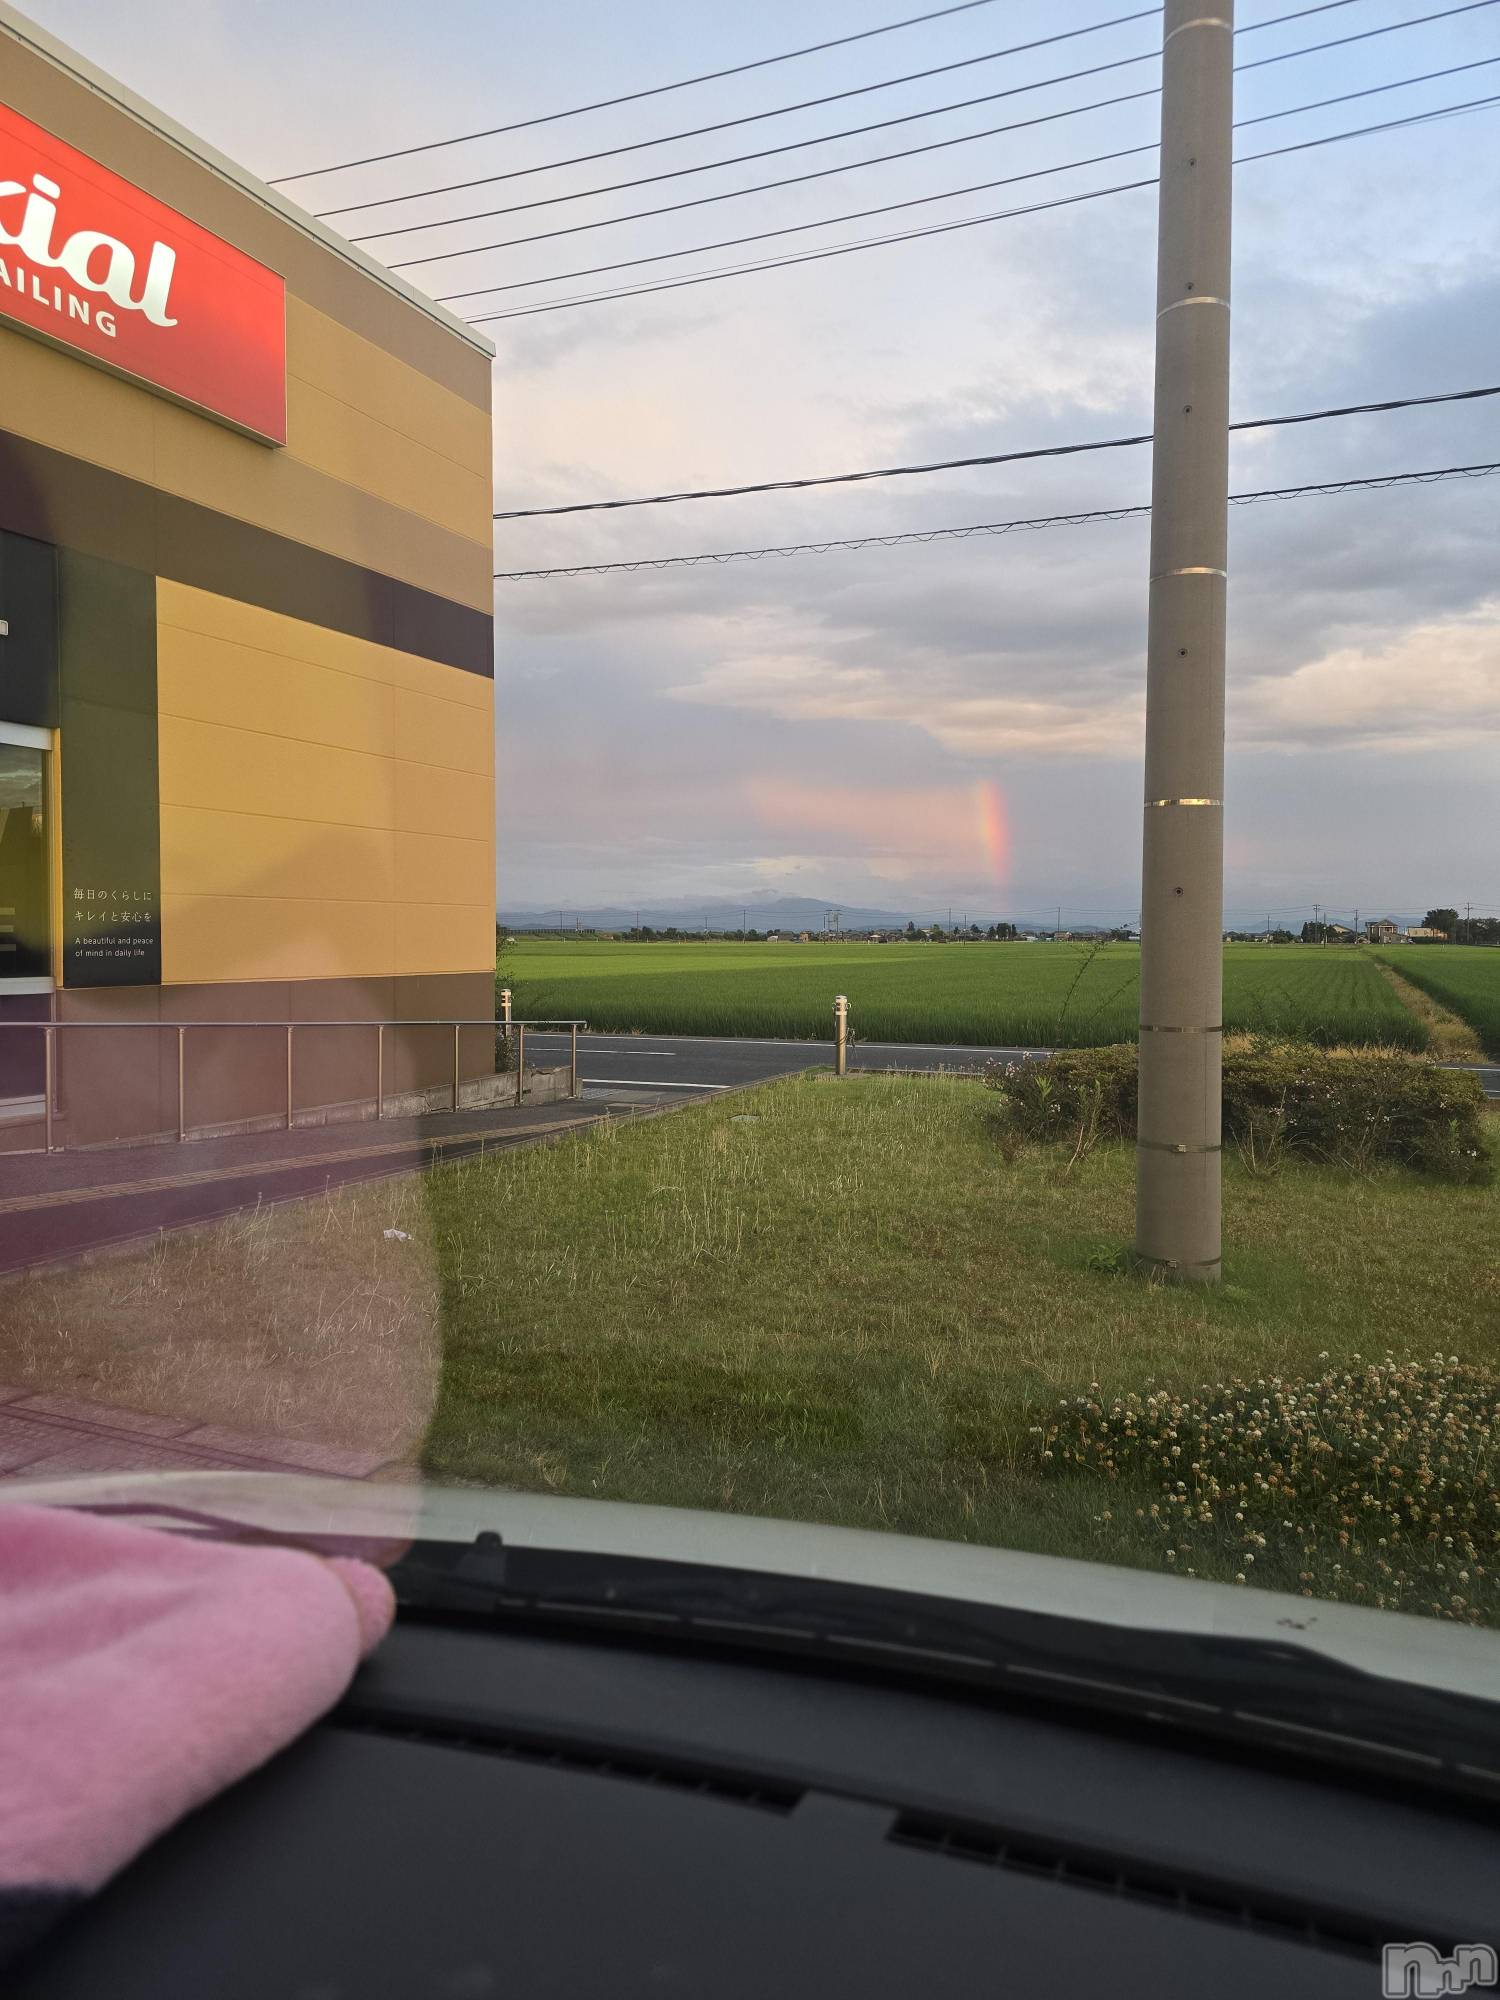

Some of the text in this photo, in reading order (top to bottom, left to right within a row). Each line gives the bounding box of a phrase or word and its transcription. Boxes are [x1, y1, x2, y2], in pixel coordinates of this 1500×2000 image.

[74, 888, 152, 901] 毎日のくらしに
[74, 911, 152, 922] キレイと安心を
[75, 937, 81, 945] A
[83, 937, 116, 945] beautiful
[133, 938, 154, 946] peace
[75, 949, 83, 957] of
[85, 949, 104, 957] mind
[105, 949, 113, 957] in
[114, 949, 132, 958] daily
